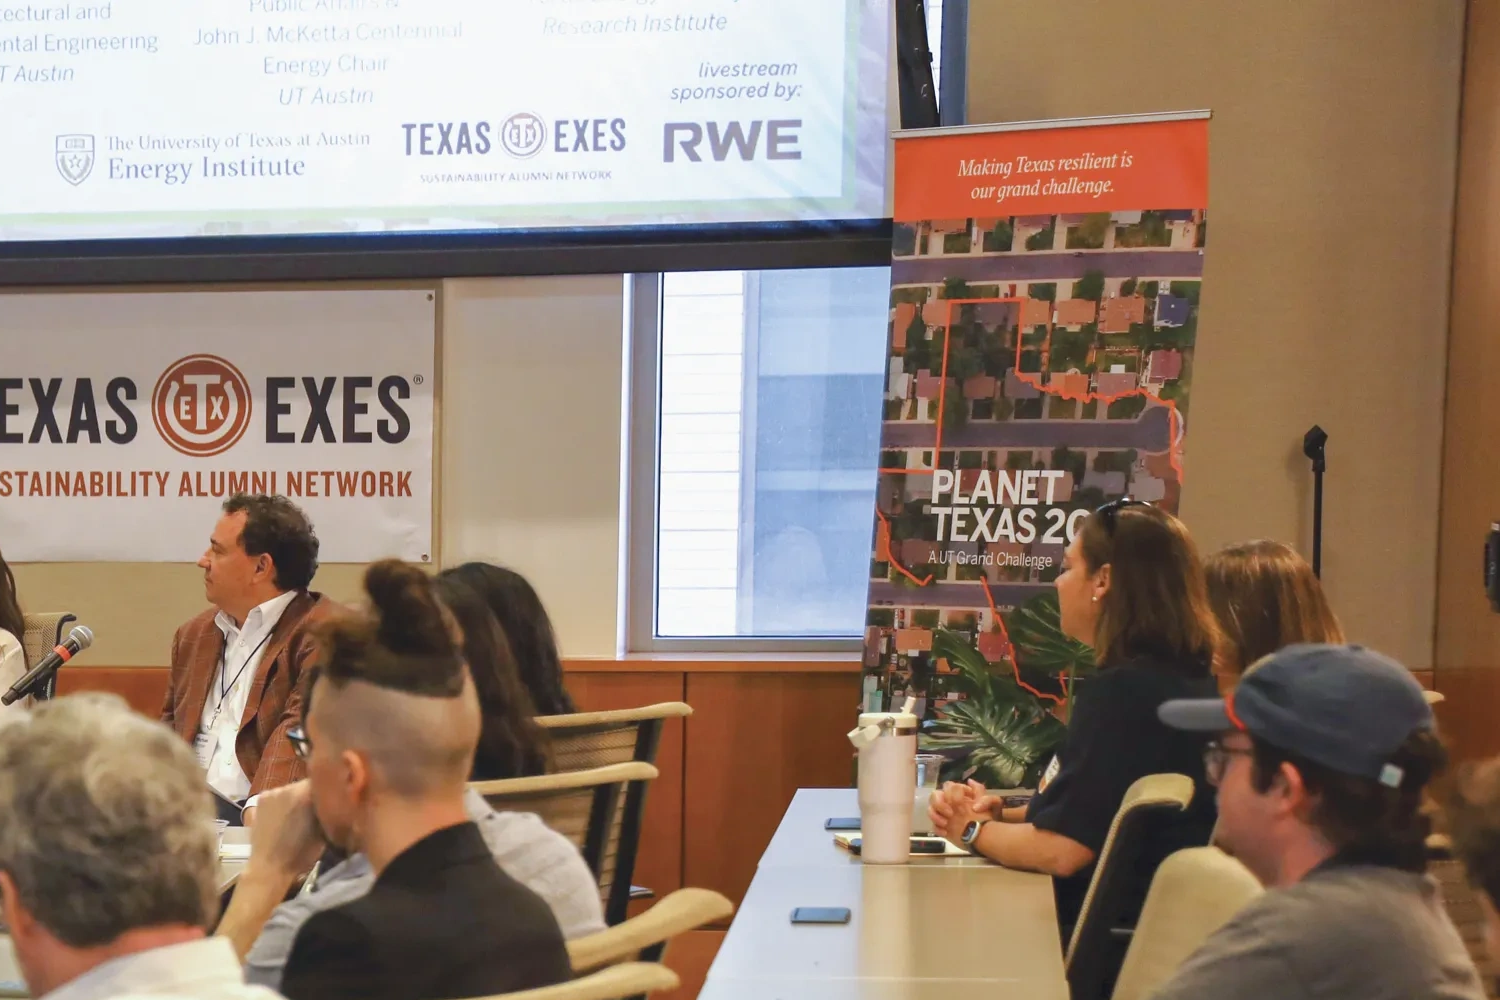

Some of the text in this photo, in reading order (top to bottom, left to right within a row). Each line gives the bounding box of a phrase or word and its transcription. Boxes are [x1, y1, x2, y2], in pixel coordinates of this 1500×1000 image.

[75, 1, 111, 20] and
[542, 13, 728, 35] Research Institute
[44, 33, 159, 55] Engineering
[194, 27, 239, 46] John
[245, 26, 260, 44] J.
[267, 25, 350, 43] McKetta
[13, 64, 74, 83] Austin
[263, 54, 387, 77] Energy Chair
[698, 62, 798, 78] livestream
[279, 86, 374, 106] UT Austin
[670, 81, 803, 104] sponsored by:
[109, 136, 134, 151] The
[139, 135, 220, 153] University
[224, 132, 242, 148] of
[316, 131, 370, 146] Austin
[401, 121, 491, 156] TEXAS
[554, 117, 626, 153] EXES
[663, 119, 803, 163] RWE
[109, 155, 305, 185] Energy Institute
[957, 150, 1134, 179] Making Texas resilient is
[420, 170, 612, 184] SUSTAINABILITY ALUMNI NETWORK
[970, 176, 1114, 203] our grand challenge.
[178, 470, 277, 498] ALUMNI
[285, 470, 412, 498] NETWORK
[931, 470, 1064, 505] PLANET
[929, 507, 1037, 542] TEXAS
[928, 551, 1052, 570] A UT Grand Challenge
